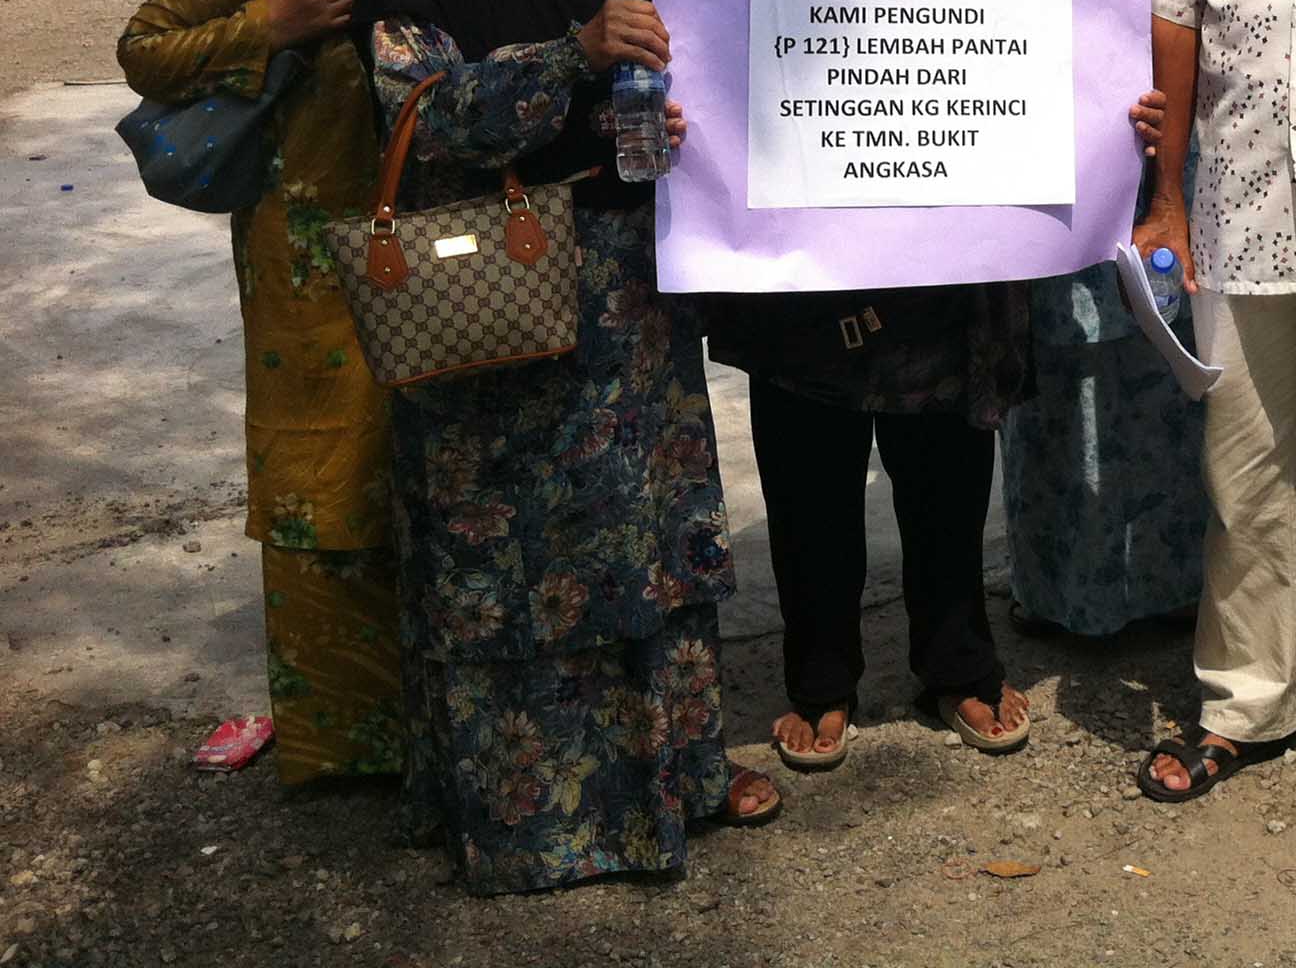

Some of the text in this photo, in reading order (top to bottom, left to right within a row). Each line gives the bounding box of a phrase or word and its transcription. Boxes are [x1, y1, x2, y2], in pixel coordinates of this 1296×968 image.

[810, 6, 984, 25] KAMI PENGUNDI
[774, 36, 1027, 58] {P 121} LEMBAH PANTAI
[828, 69, 966, 85] PINDAH DARI
[780, 99, 1026, 117] SETINGGAN KG KERINCI
[821, 130, 979, 147] KE TMN. BUKIT
[843, 161, 947, 178] ANGKASA
